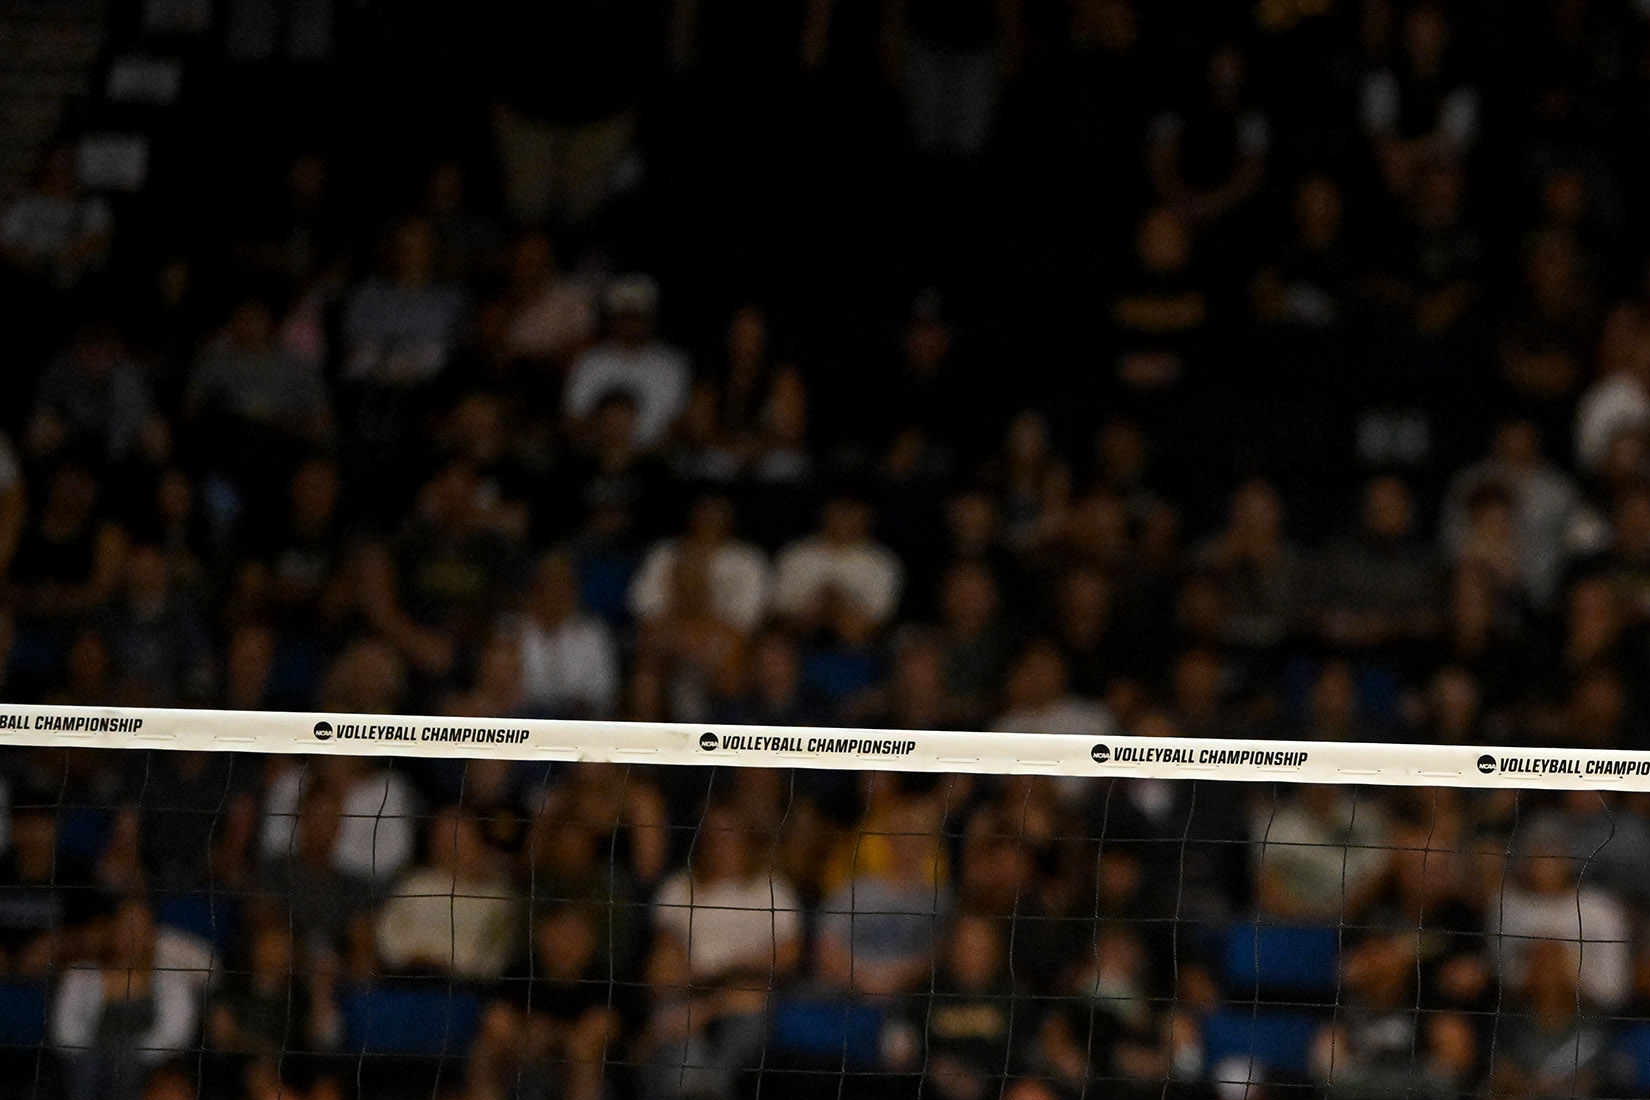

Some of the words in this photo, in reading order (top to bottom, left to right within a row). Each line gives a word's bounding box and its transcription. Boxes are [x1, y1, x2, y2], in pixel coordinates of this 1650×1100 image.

[34, 715, 143, 733] CHAMPIONSHIP
[336, 724, 417, 741] VOLLEYBALL
[421, 727, 530, 744] CHAMPIONSHIP
[722, 735, 803, 752] VOLLEYBALL
[807, 738, 916, 755] CHAMPIONSHIP
[1114, 747, 1195, 764] VOLLEYBALL
[1198, 749, 1308, 767] CHAMPIONSHIP
[1500, 757, 1581, 774] VOLLEYBALL
